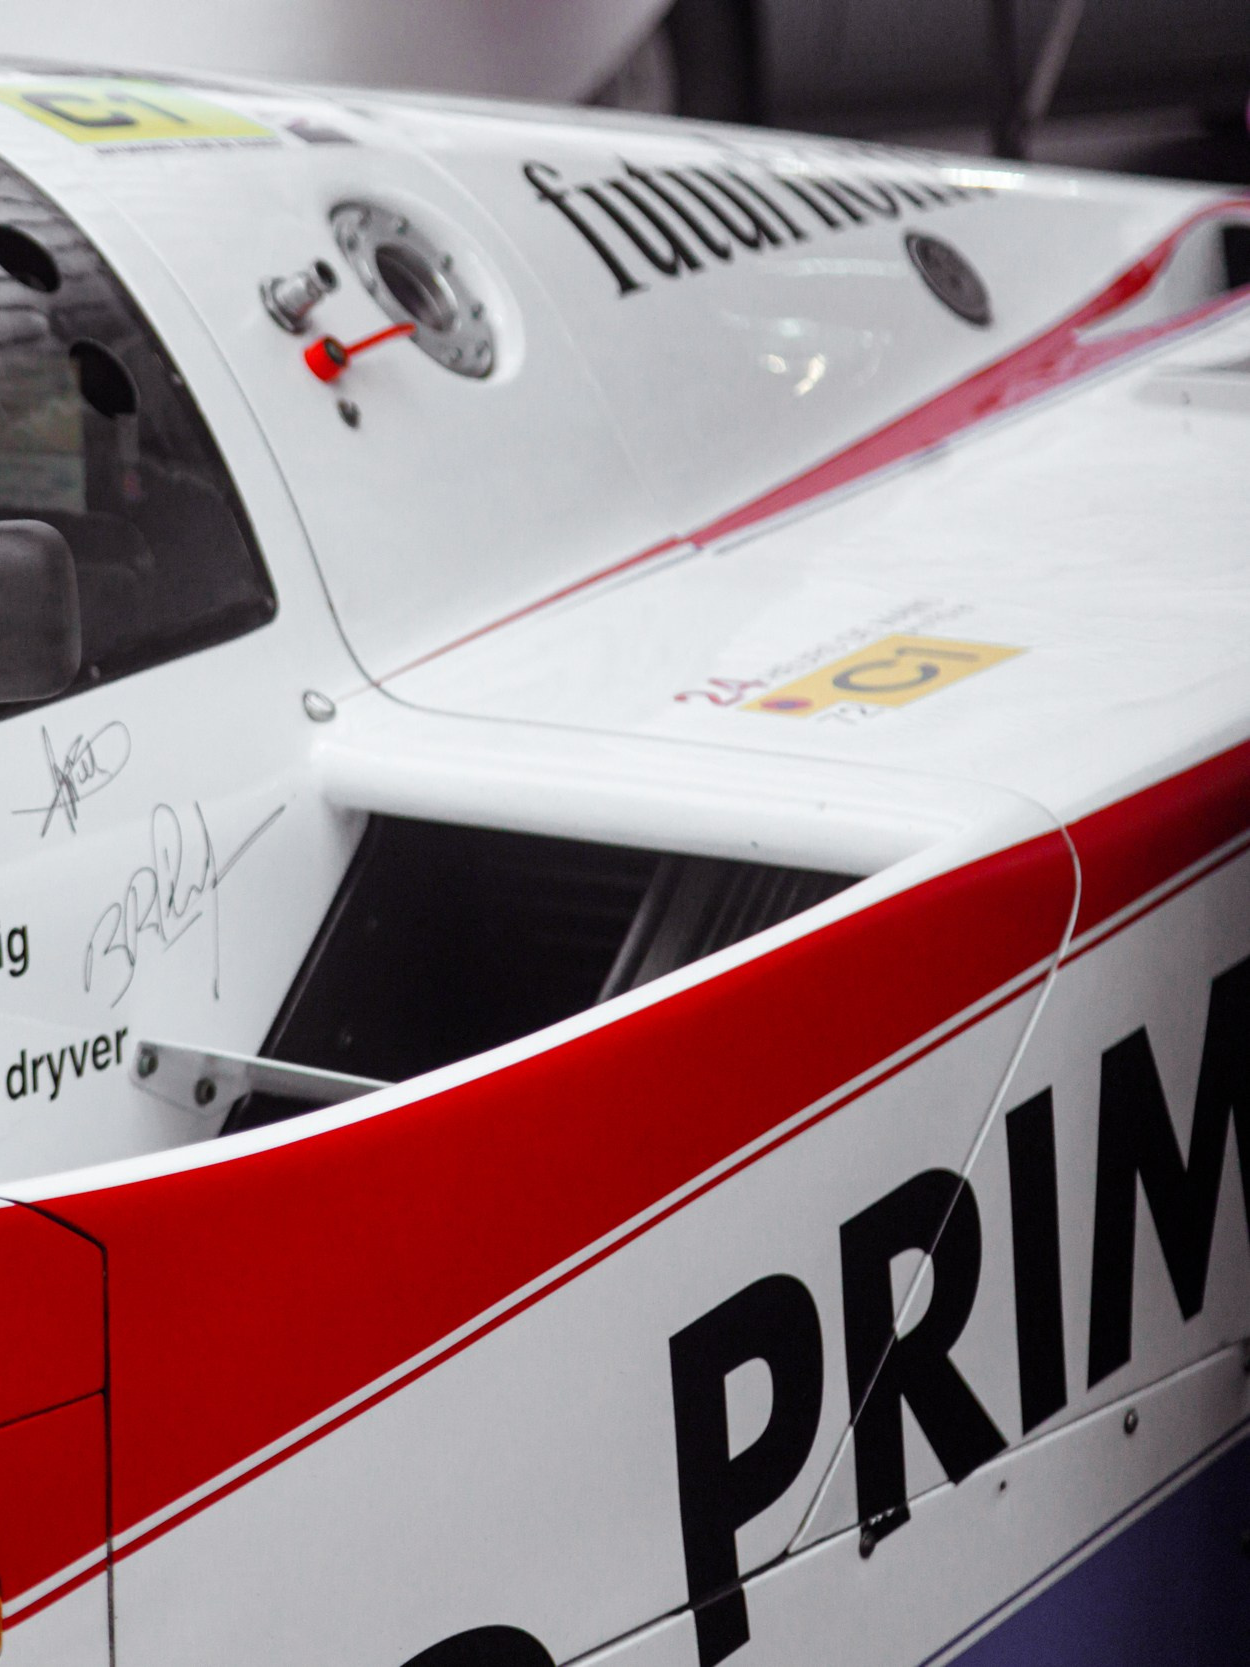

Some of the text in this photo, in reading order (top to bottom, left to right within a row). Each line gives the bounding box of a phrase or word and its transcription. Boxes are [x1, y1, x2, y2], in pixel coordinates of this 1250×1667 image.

[832, 645, 981, 692] C1
[5, 1027, 129, 1101] dryver
[669, 954, 1250, 1667] PRIM
